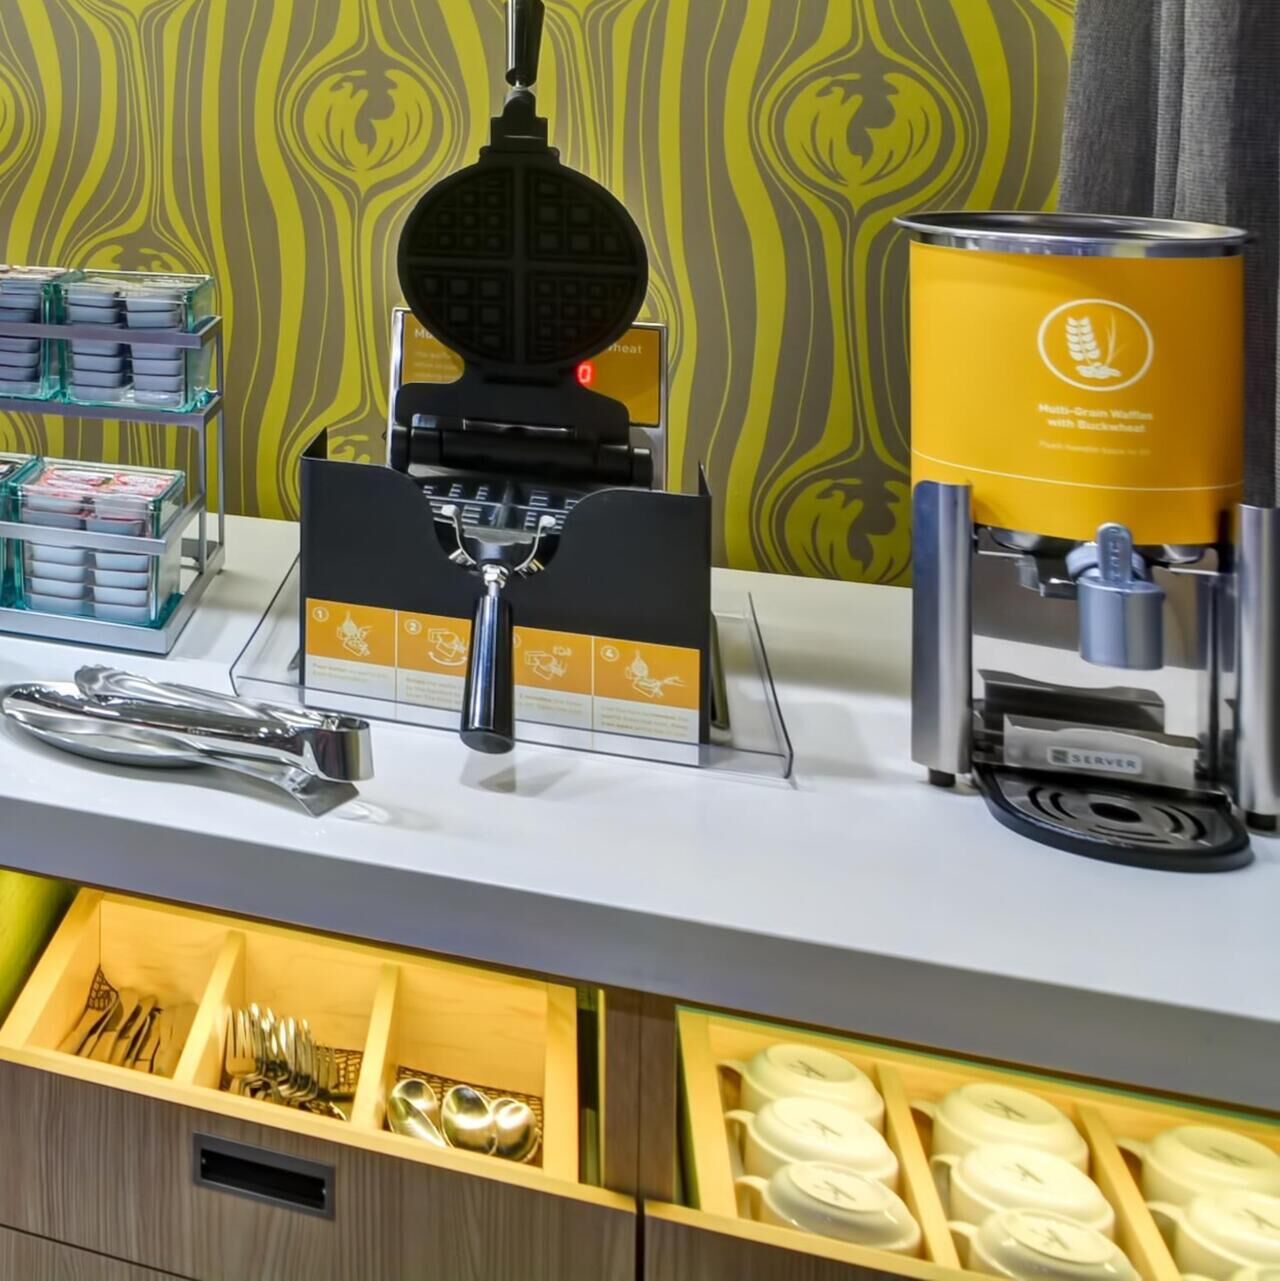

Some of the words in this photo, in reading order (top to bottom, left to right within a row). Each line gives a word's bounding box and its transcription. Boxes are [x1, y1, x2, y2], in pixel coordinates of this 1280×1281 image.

[578, 365, 591, 382] 0
[1047, 418, 1074, 428] with
[1071, 754, 1137, 769] SERVER
